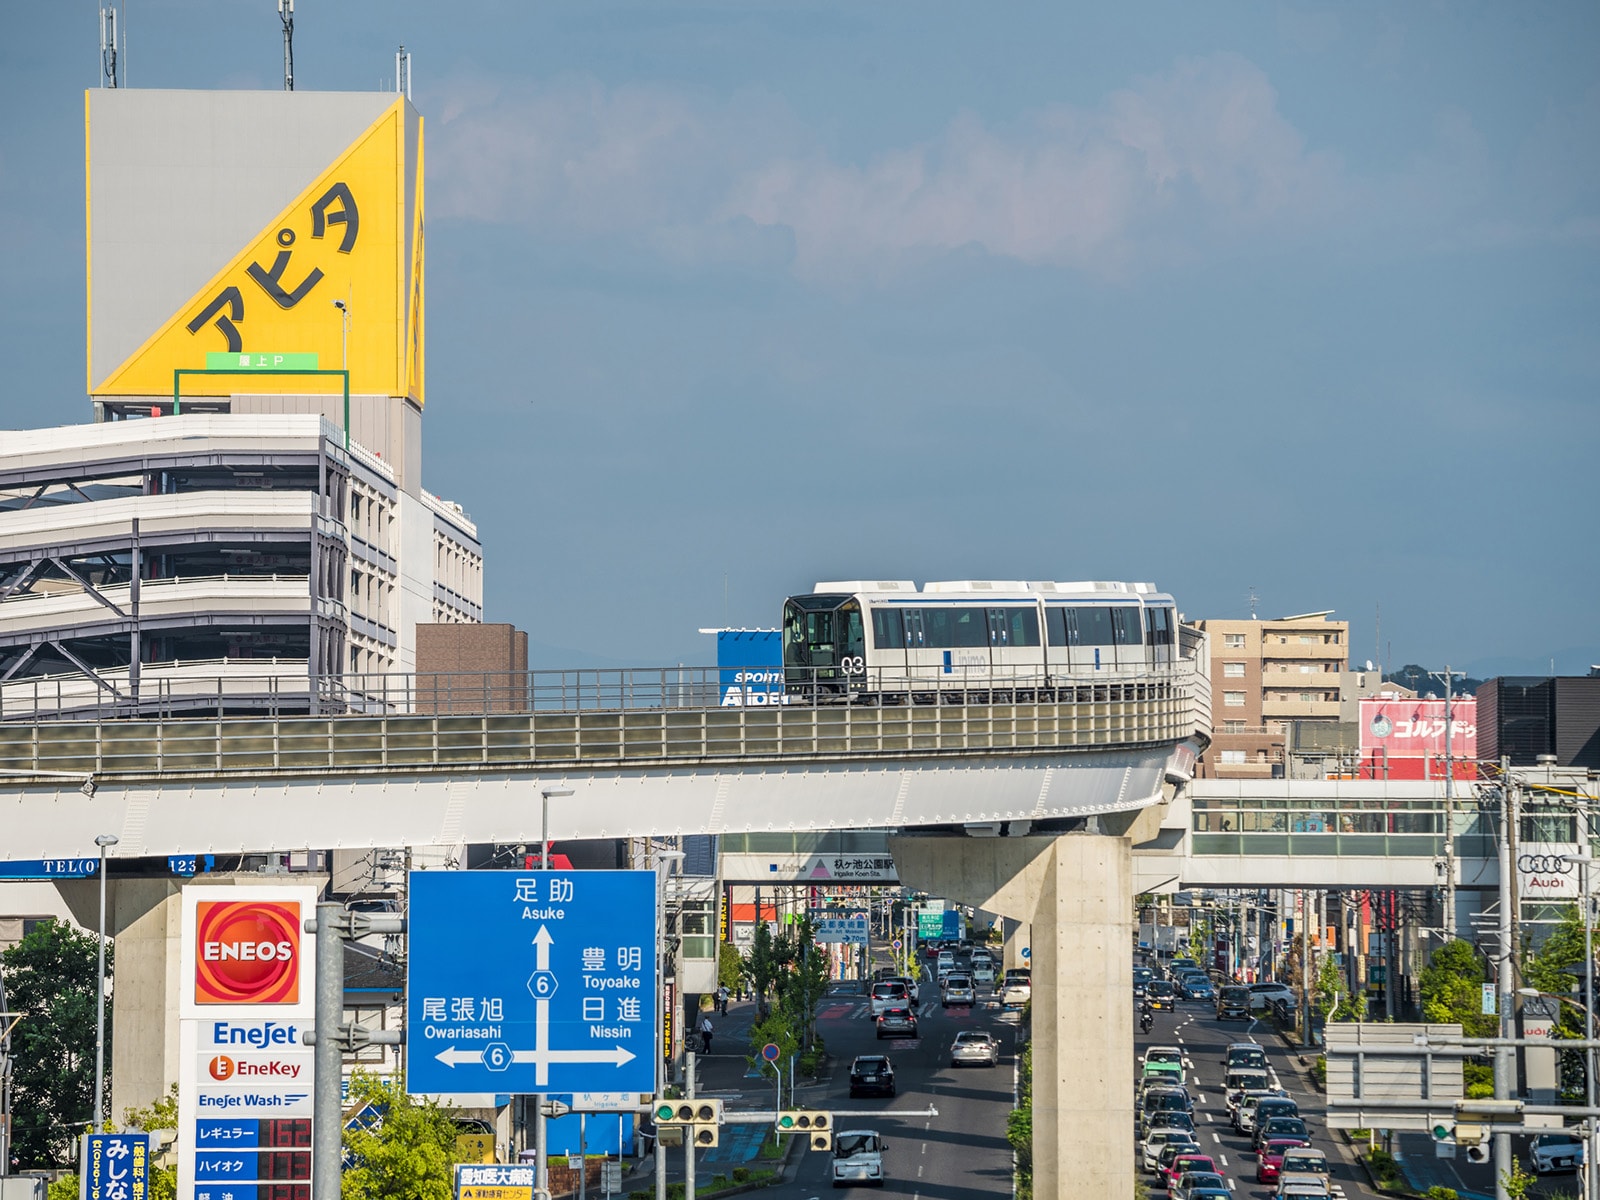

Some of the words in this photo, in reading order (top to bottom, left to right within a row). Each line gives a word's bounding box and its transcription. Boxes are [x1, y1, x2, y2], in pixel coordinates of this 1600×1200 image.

[186, 182, 359, 353] アピタ
[841, 656, 865, 675] 03
[43, 860, 98, 873] TEL(0
[513, 878, 574, 903] 足助
[1529, 876, 1565, 888] Audi
[522, 906, 565, 920] Asuke
[203, 941, 293, 962] ENEOS
[581, 947, 642, 972] 豊明
[536, 976, 549, 994] 6
[582, 975, 641, 991] Toyoake
[422, 997, 504, 1021] 尾張旭
[582, 997, 642, 1022] 日進
[424, 1025, 502, 1039] Owariasahi
[590, 1025, 632, 1038] Nissin
[1522, 1027, 1547, 1036] udi
[491, 1048, 504, 1066] 6
[237, 1061, 301, 1078] EneKey
[243, 1094, 282, 1106] Wash
[200, 1127, 255, 1139] レギュラー
[269, 1119, 312, 1147] 162
[105, 1139, 130, 1200] みしな
[199, 1160, 244, 1172] ハイオク
[268, 1151, 312, 1180] 173
